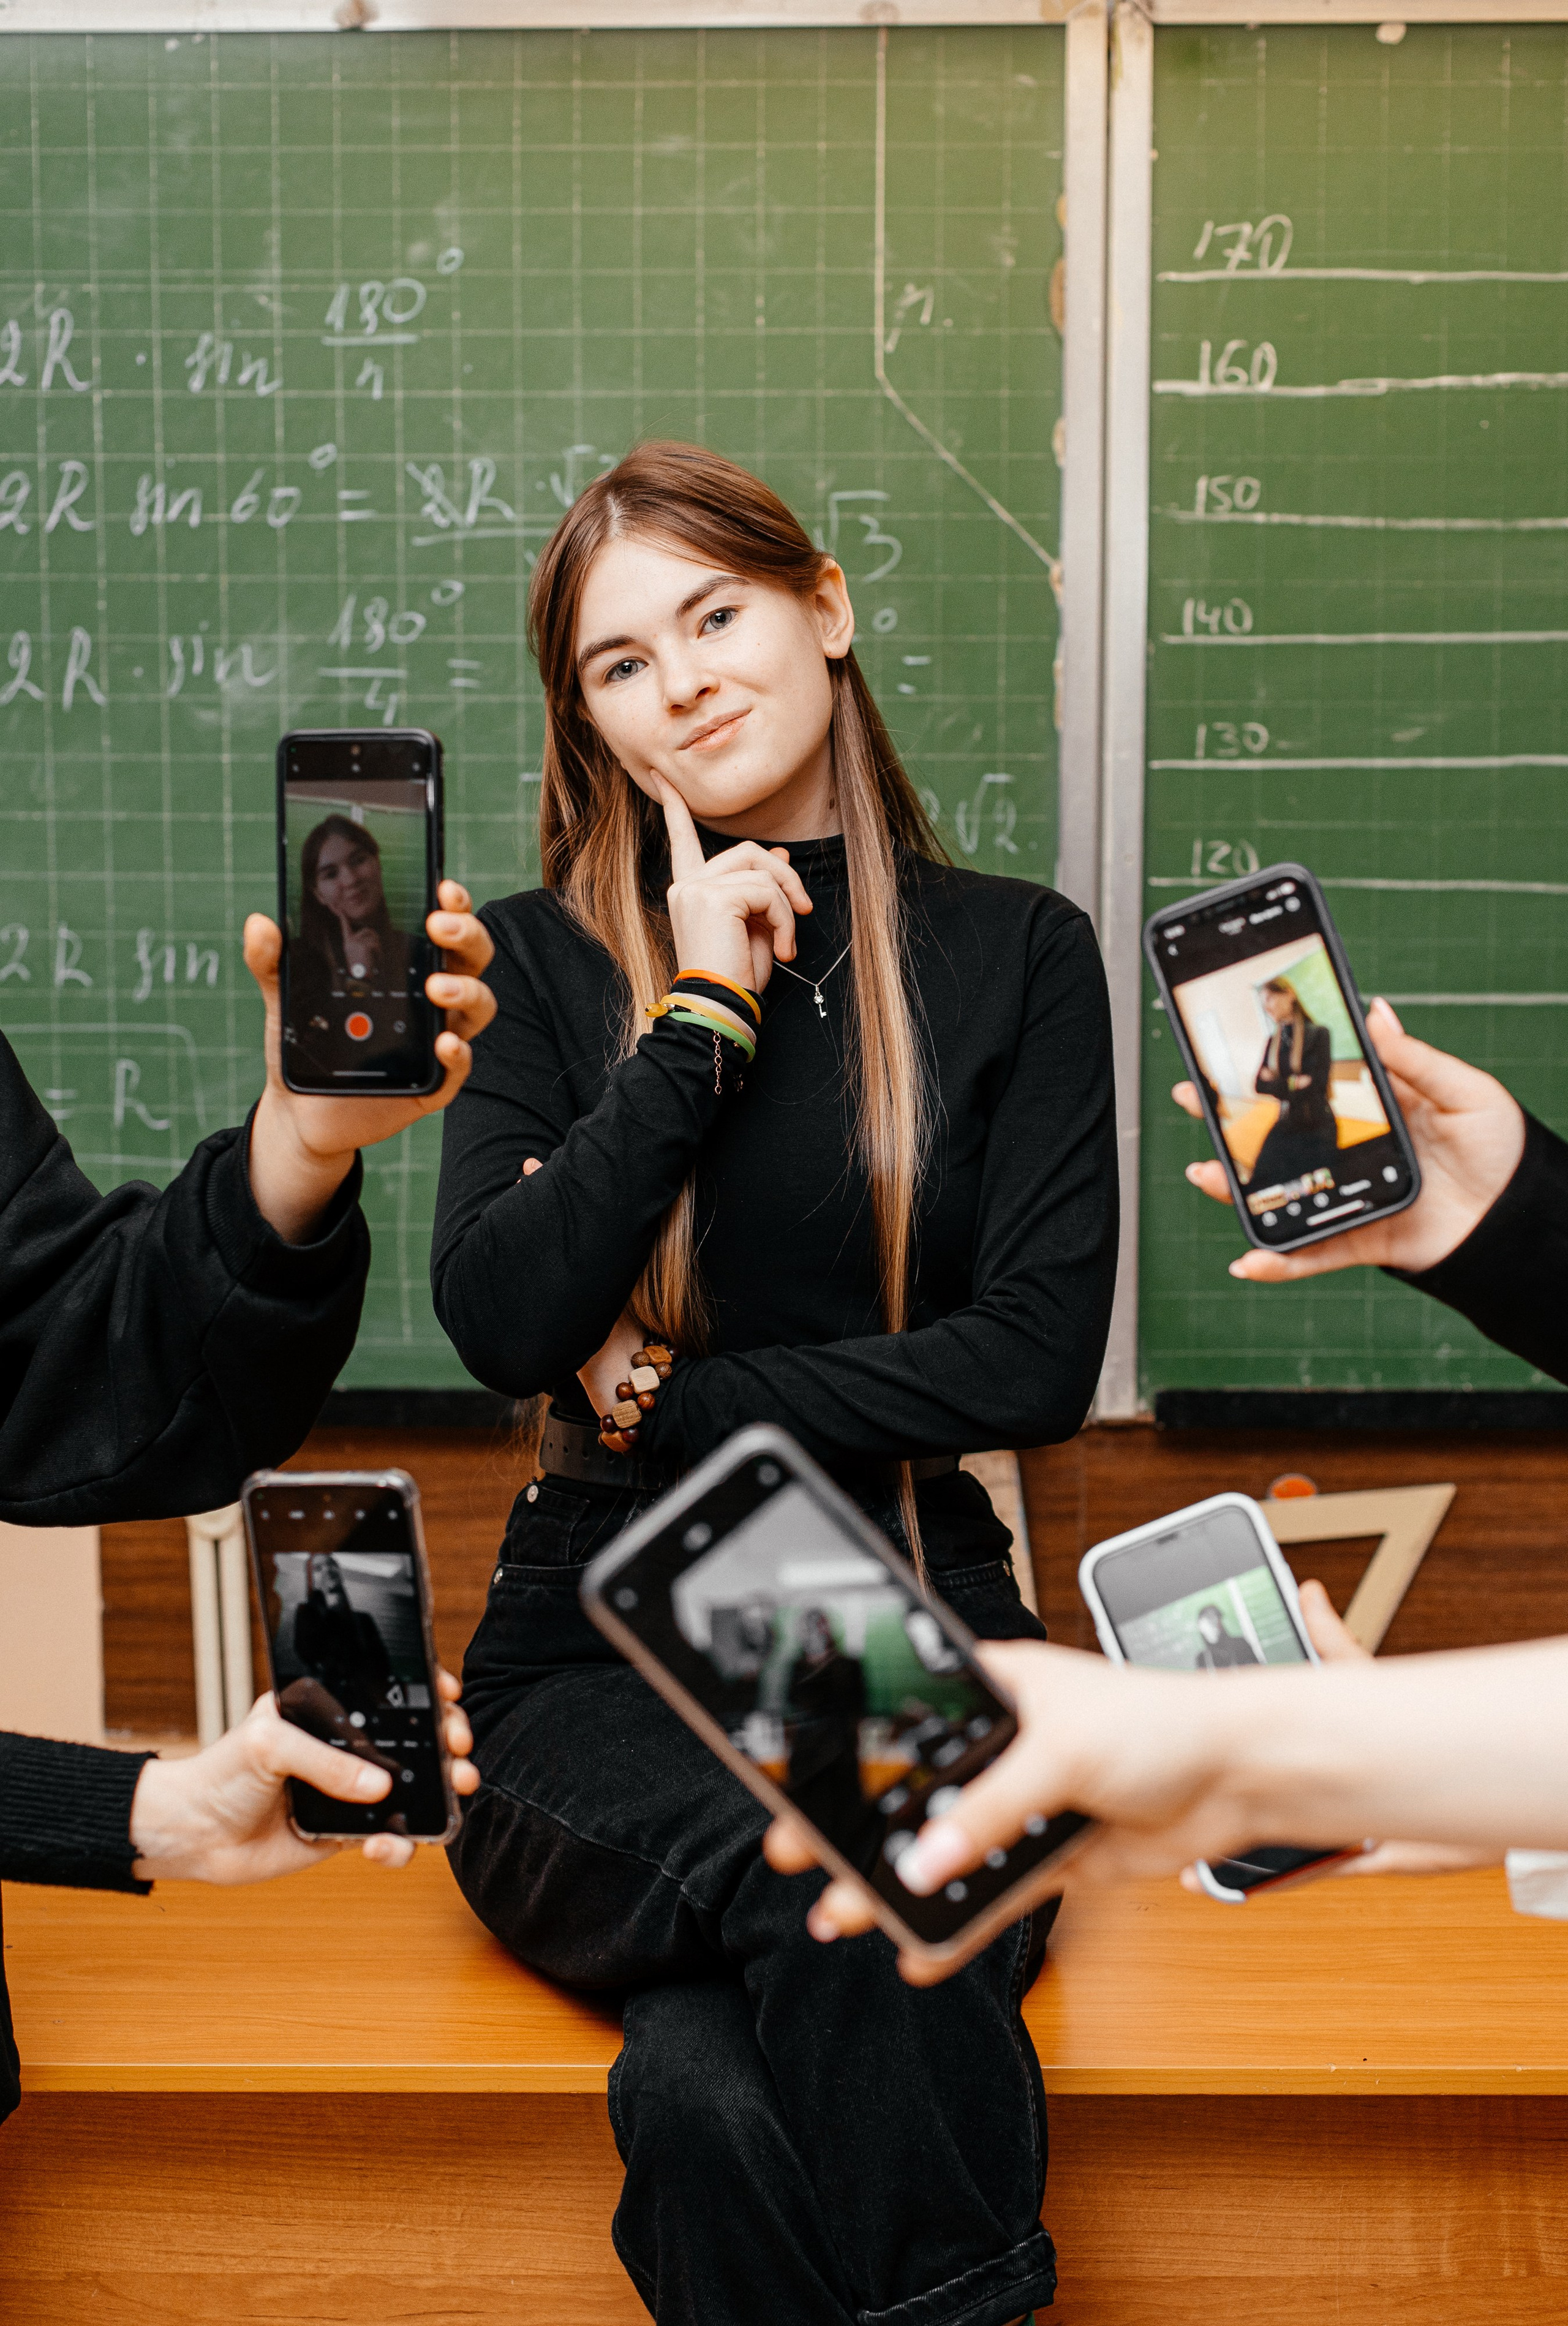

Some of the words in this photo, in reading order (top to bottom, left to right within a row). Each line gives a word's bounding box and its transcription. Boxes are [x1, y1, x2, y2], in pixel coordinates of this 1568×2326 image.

[1193, 214, 1293, 274] 170
[1199, 339, 1277, 393] 160
[1194, 475, 1261, 518] 150
[1182, 598, 1253, 635] 140
[1195, 722, 1269, 759] 130
[1191, 837, 1259, 877] 120
